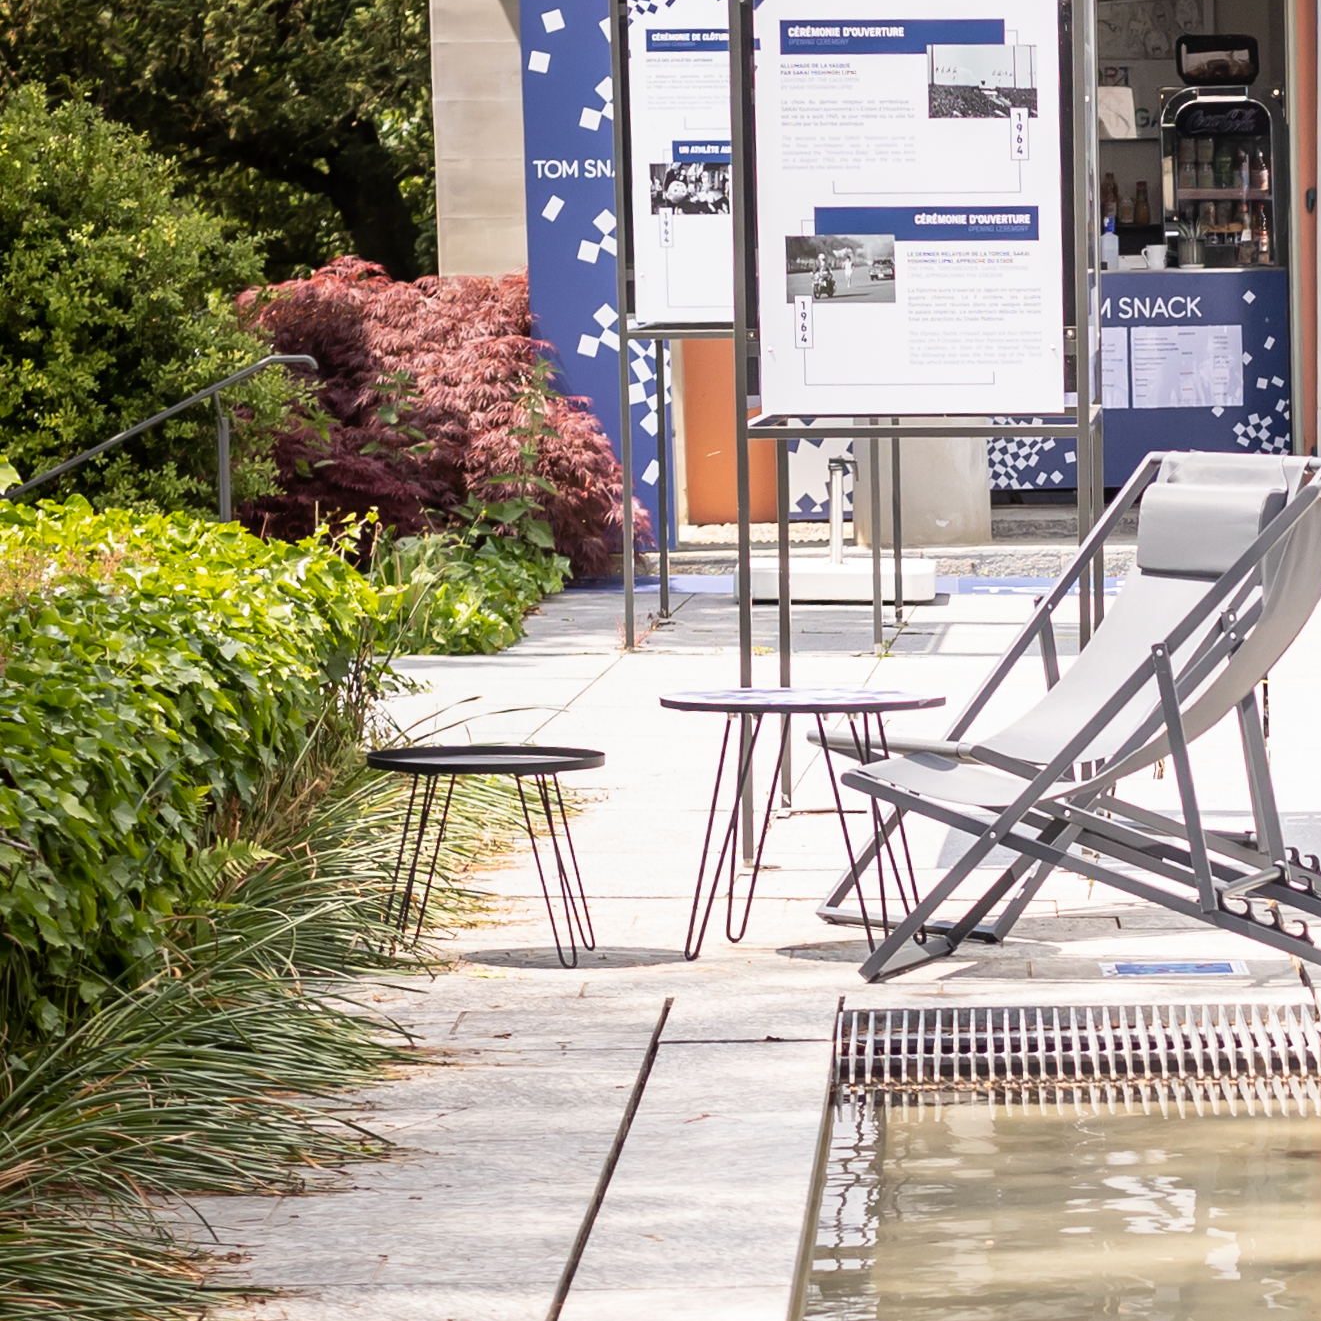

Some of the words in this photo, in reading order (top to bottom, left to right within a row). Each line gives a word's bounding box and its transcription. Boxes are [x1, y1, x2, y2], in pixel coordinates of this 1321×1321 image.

[702, 32, 730, 41] CLÔTUR
[788, 25, 841, 37] CÉRÉMONIE
[842, 26, 905, 37] D'OUVERTURE
[532, 159, 579, 179] TOM
[914, 212, 967, 225] CÉRÉMONIE
[968, 213, 1031, 225] D'OUVERTURE
[1118, 296, 1202, 319] SNACK
